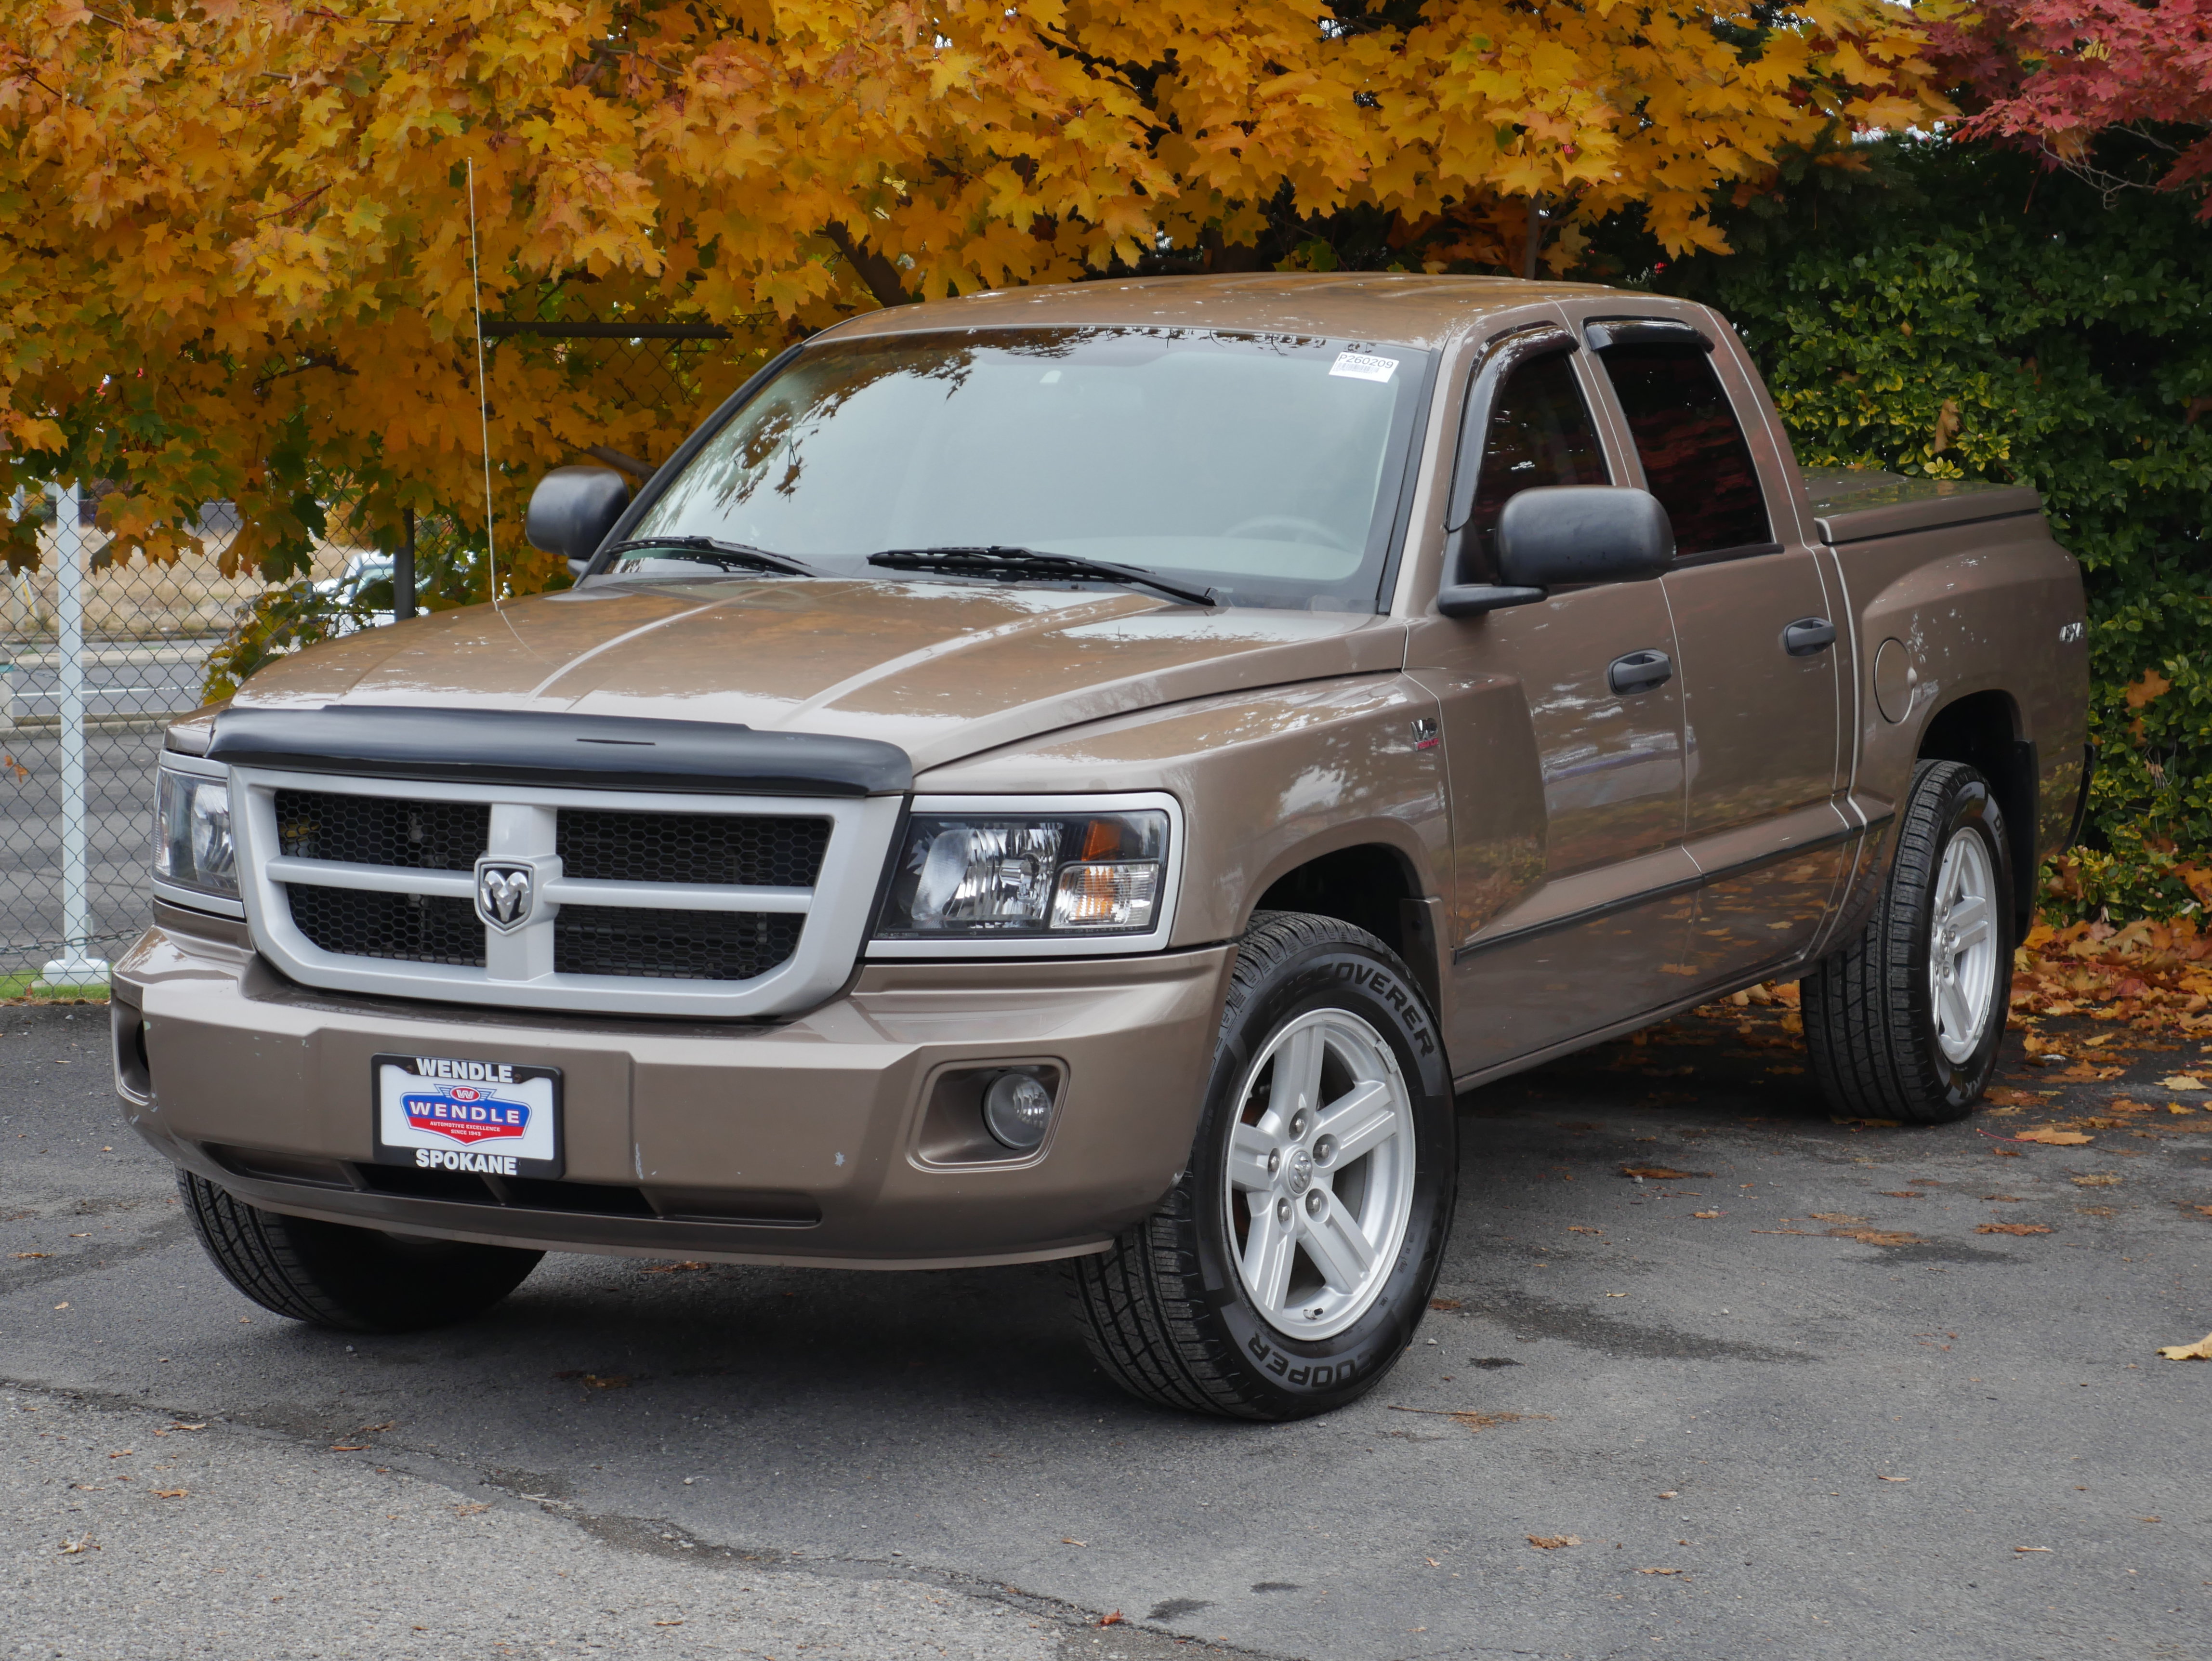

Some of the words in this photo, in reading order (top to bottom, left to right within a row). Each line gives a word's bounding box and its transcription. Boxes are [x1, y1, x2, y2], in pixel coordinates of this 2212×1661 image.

[1338, 354, 1394, 369] P260209
[416, 1058, 514, 1083] WENDLE
[409, 1101, 520, 1124] WENDLE
[415, 1149, 517, 1175] SPOKANE
